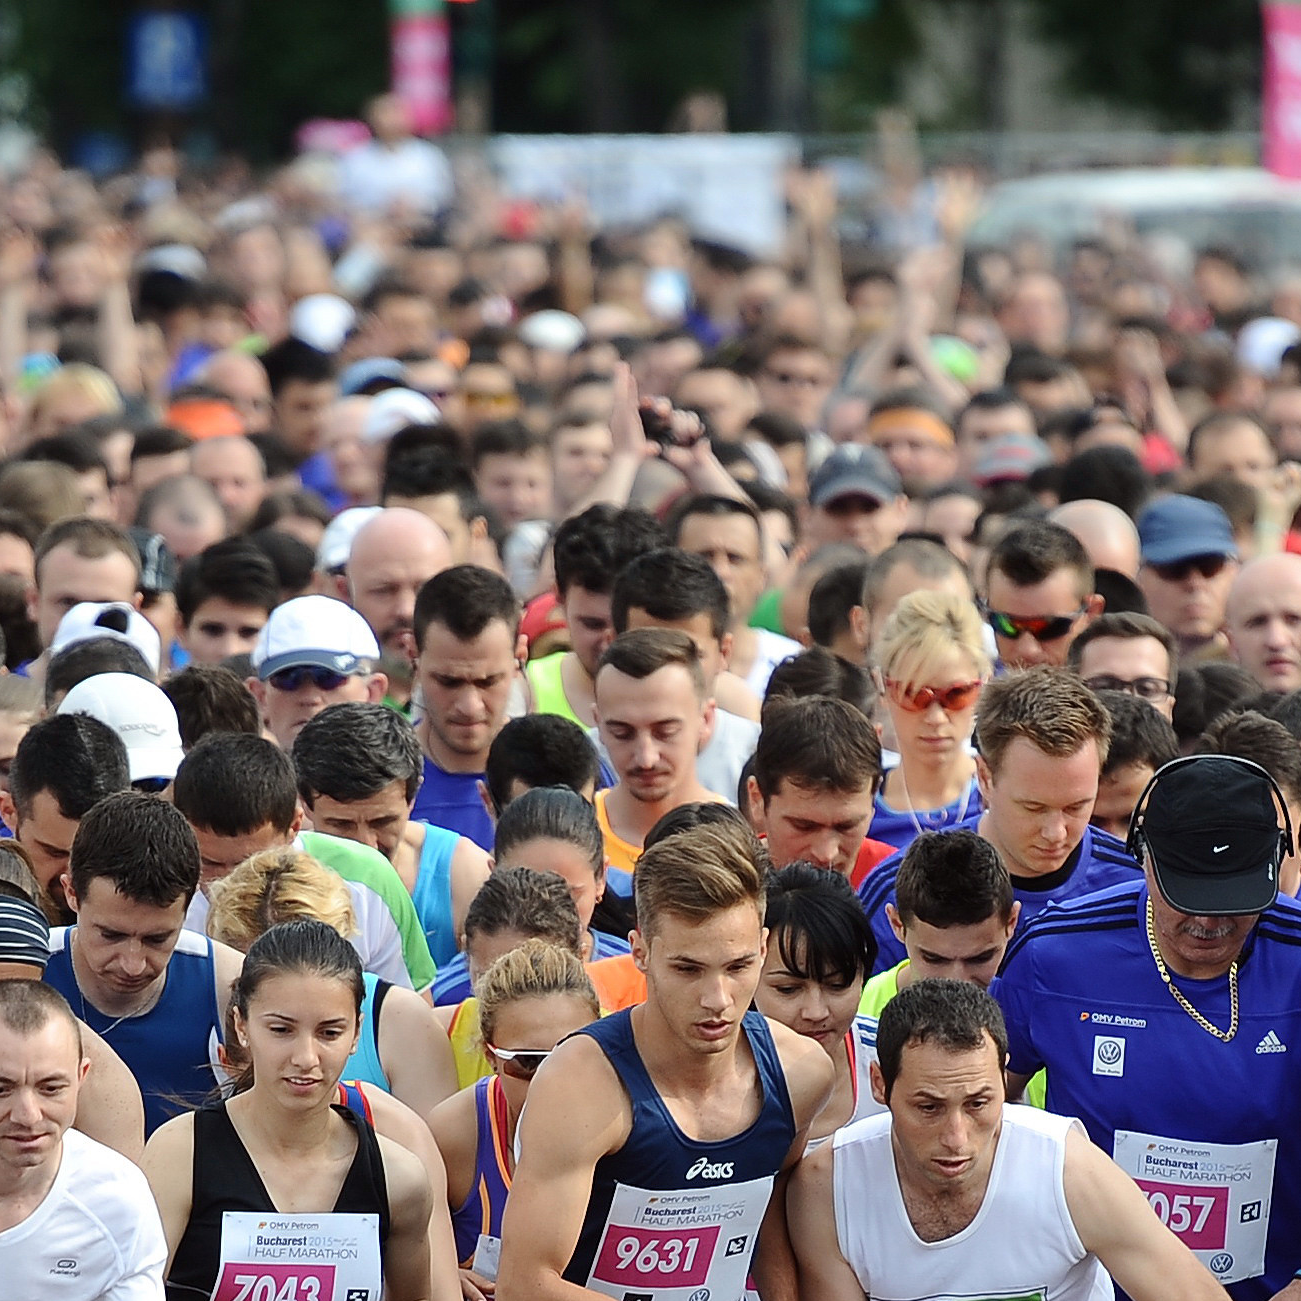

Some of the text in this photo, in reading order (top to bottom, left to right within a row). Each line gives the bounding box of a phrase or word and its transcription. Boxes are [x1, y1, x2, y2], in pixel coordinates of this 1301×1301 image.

[1091, 1013, 1147, 1029] OMV Petrom
[1255, 1044, 1287, 1055] adidas
[1158, 1143, 1211, 1157] OMV Petrom
[1145, 1155, 1225, 1172] Bucharest 2015
[1144, 1165, 1252, 1182] HALF MARATHON
[660, 1194, 711, 1204] OMV Petrom
[641, 1209, 745, 1225] HALF MARATHON
[644, 1205, 697, 1217] Bucharest
[1141, 1190, 1216, 1234] 057
[269, 1222, 319, 1230] OMV Petrom
[256, 1235, 334, 1247] Bucharest 2015
[254, 1247, 358, 1259] HALF MARATHON
[615, 1236, 700, 1274] 9631
